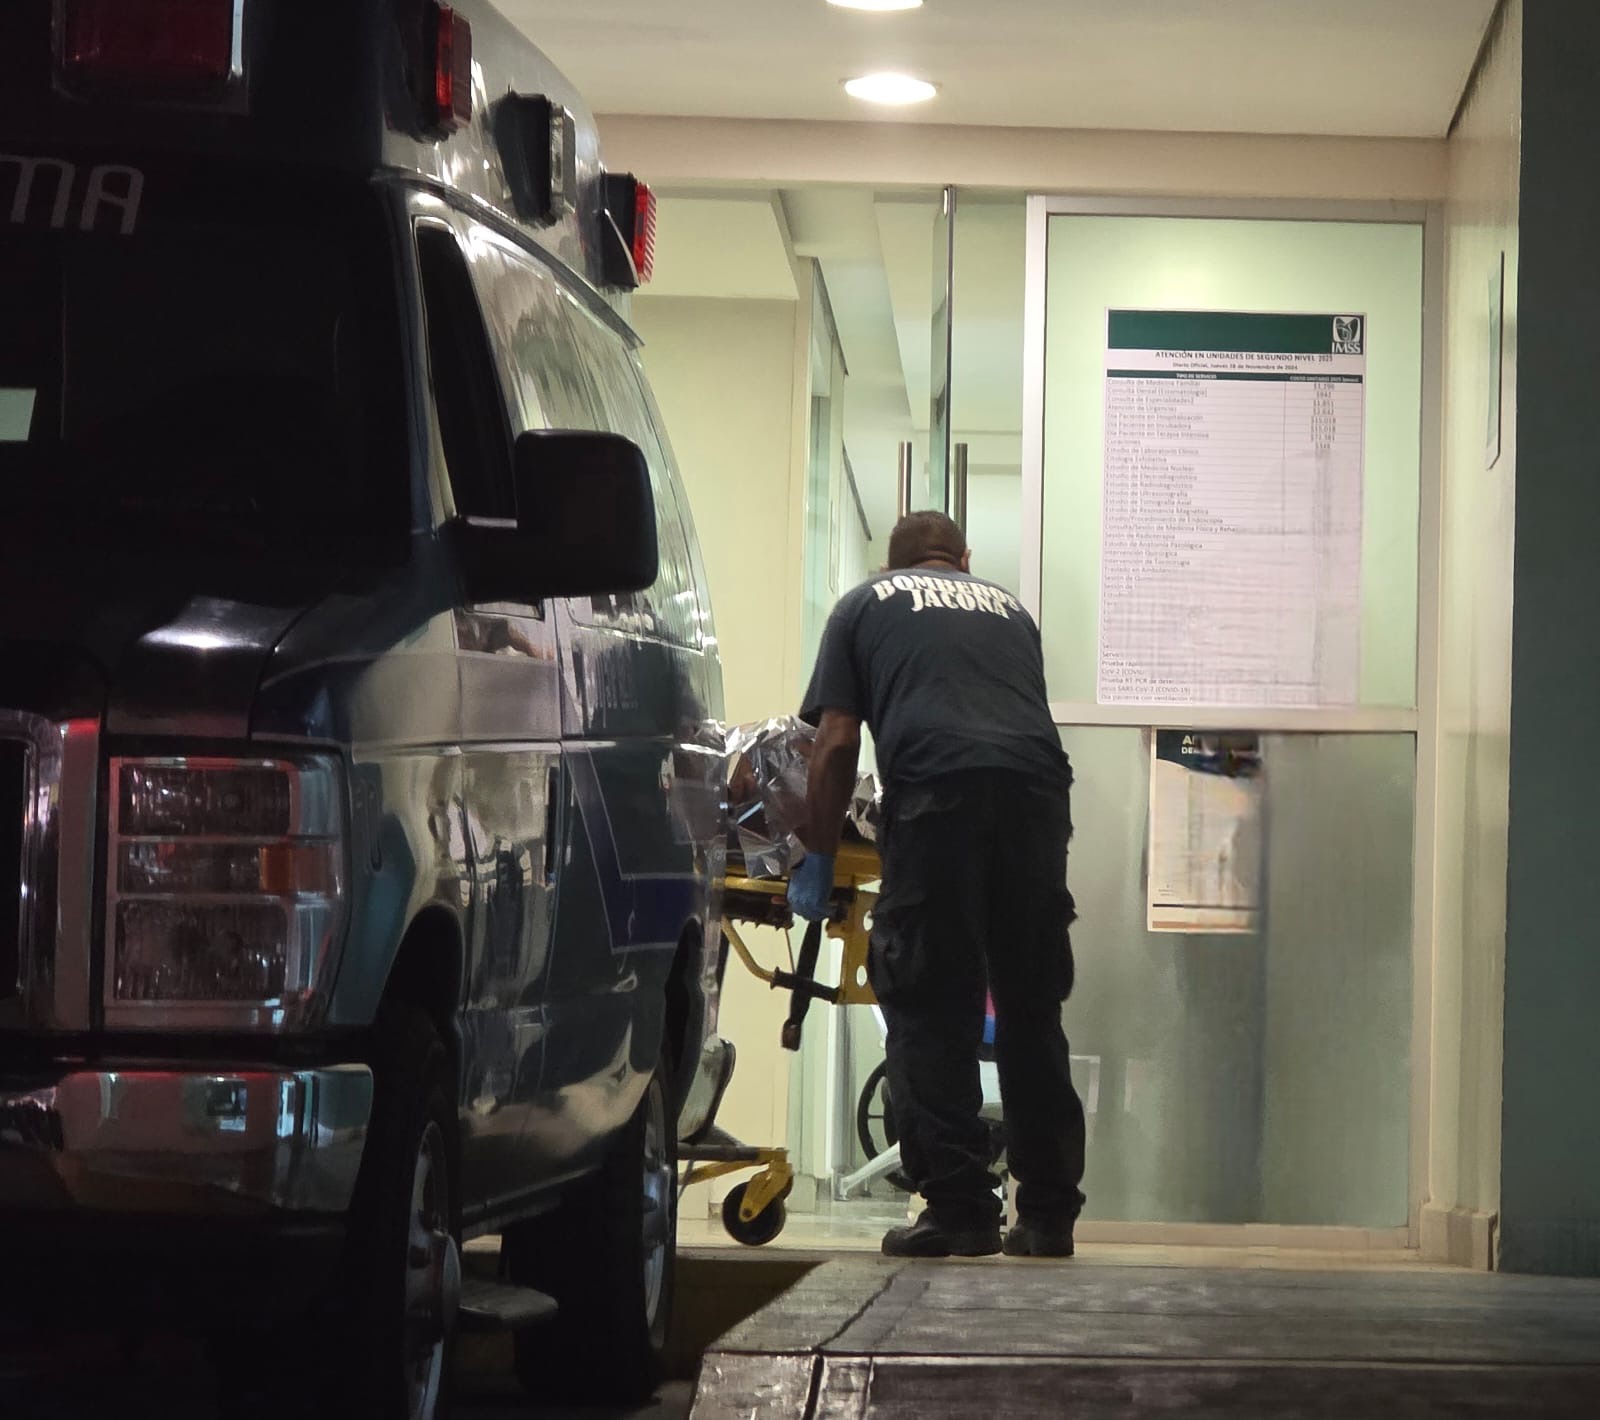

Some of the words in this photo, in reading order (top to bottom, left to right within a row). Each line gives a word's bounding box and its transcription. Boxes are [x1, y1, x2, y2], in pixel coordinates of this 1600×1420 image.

[1331, 341, 1361, 354] IMSS
[1155, 350, 1193, 359] ATENCIÓN
[1206, 352, 1243, 360] UNIDADES
[1256, 353, 1293, 361] SEGUNDO
[911, 589, 1009, 619] JACONA
